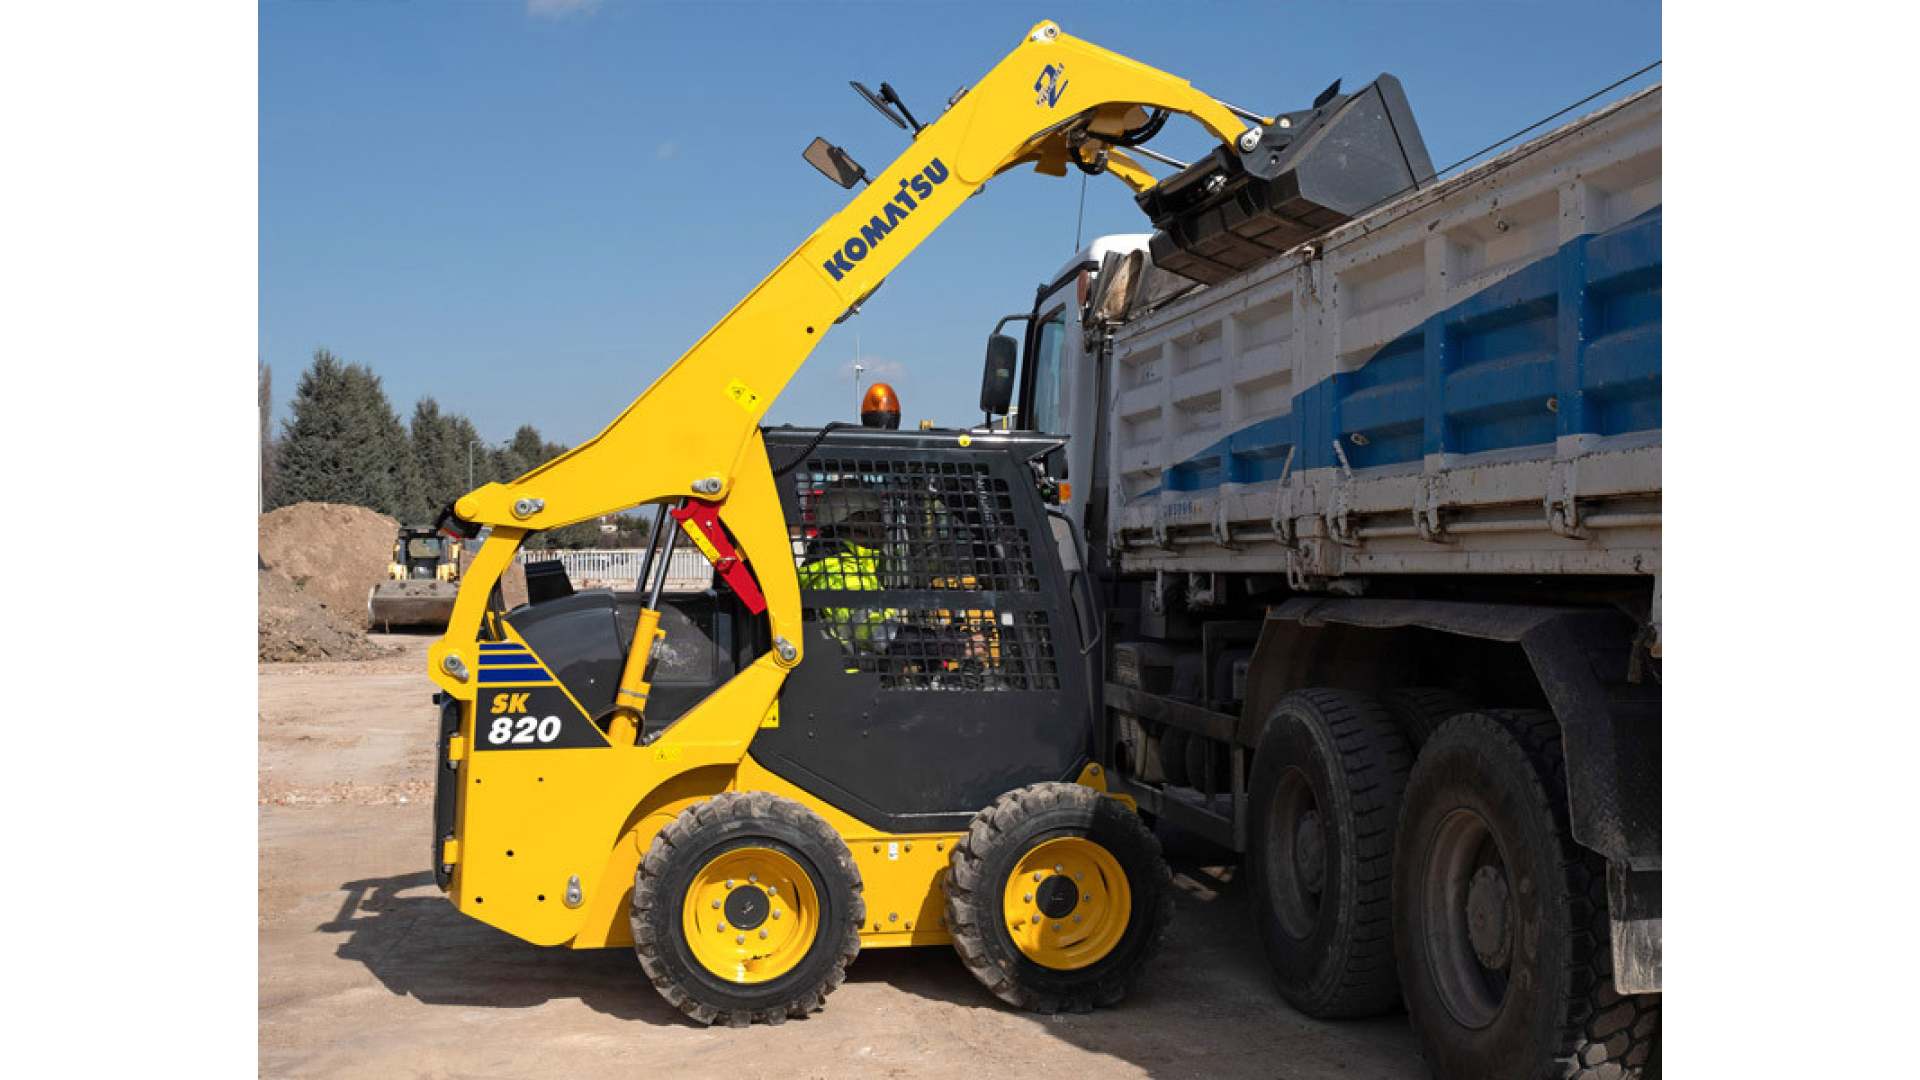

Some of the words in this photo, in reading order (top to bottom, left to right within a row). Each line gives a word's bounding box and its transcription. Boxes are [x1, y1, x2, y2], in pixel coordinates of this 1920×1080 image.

[823, 157, 949, 281] KOMATSU
[490, 692, 531, 714] SK
[488, 716, 562, 744] 820
